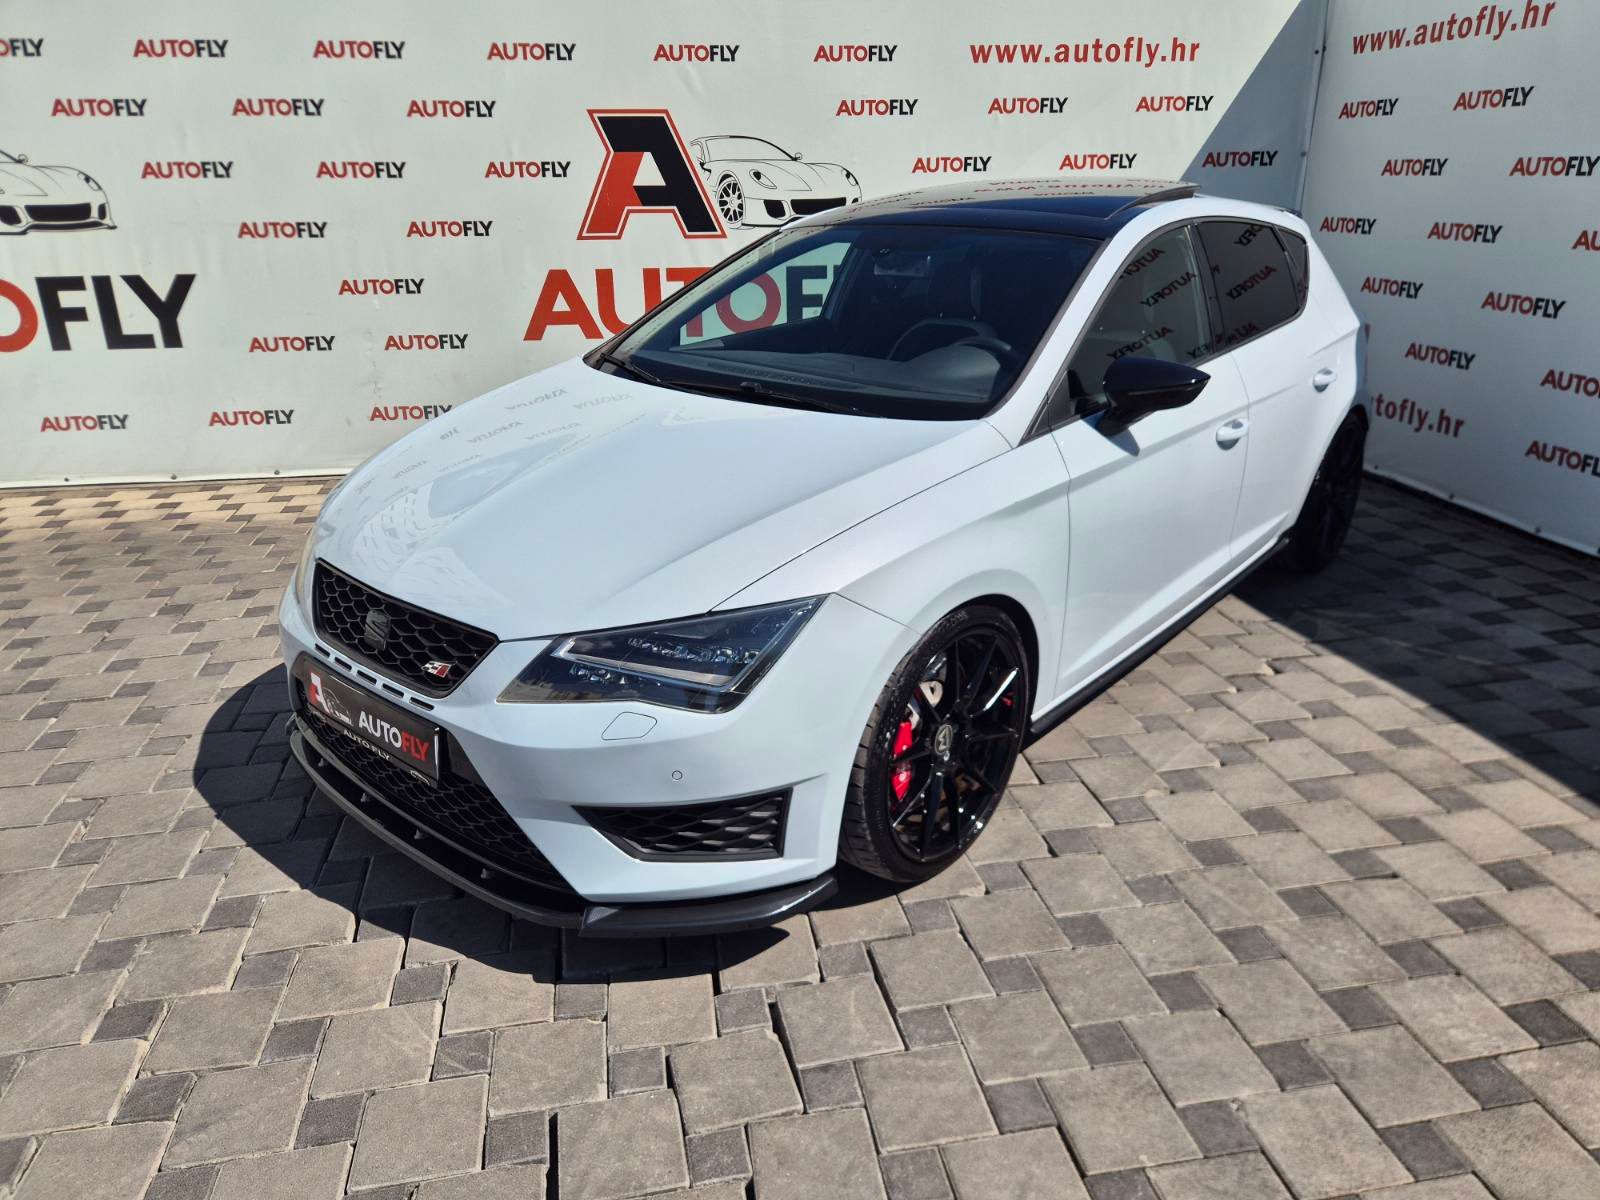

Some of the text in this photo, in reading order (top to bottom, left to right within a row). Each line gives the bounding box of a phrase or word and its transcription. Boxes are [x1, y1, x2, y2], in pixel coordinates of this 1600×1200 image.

[1352, 0, 1556, 55] www.autofly.hr
[133, 39, 229, 58] AUTOFLY
[313, 40, 406, 60] AUTOFLY
[487, 42, 577, 61] AUTOFLY
[653, 43, 740, 63] AUTOFLY
[813, 44, 898, 63] AUTOFLY
[969, 36, 1200, 68] www.autofly.hr
[51, 98, 147, 117] AUTOFLY
[231, 98, 325, 117] AUTOFLY
[835, 98, 919, 117] AUTOFLY
[987, 96, 1069, 115] AUTOFLY
[1135, 95, 1215, 113] AUTOFLY
[1452, 85, 1535, 112] AUTOFLY
[406, 99, 497, 118] AUTOFLY
[1338, 97, 1399, 120] AUTOFLY
[911, 155, 992, 174] AUTOFLY
[1059, 153, 1138, 171] AUTOFLY
[1201, 150, 1279, 168] AUTOFLY
[1380, 158, 1449, 177] AUTOFLY
[1509, 155, 1600, 177] AUTOFLY
[141, 161, 234, 179] AUTOFLY
[316, 161, 407, 179] AUTOFLY
[484, 160, 571, 179] AUTOFLY
[237, 221, 328, 239] AUTOFLY
[406, 220, 493, 238] AUTOFLY
[1319, 216, 1377, 235] AUTOFLY
[1427, 221, 1503, 244] AUTOFLY
[338, 278, 425, 296] AUTOFLY
[1360, 276, 1424, 300] AUTOFLY
[523, 265, 840, 341] AUTOF
[1480, 291, 1567, 320] AUTOFLY
[248, 335, 336, 353] AUTOFLY
[384, 333, 469, 351] AUTOFLY
[1404, 342, 1477, 371] AUTOFLY
[1539, 369, 1600, 399] AUTO
[40, 414, 129, 433] AUTOFLY
[208, 409, 295, 427] AUTOFLY
[1370, 393, 1466, 439] tofly.hr
[343, 729, 391, 761] AUTO FLY
[358, 710, 430, 761] AUTOFLY
